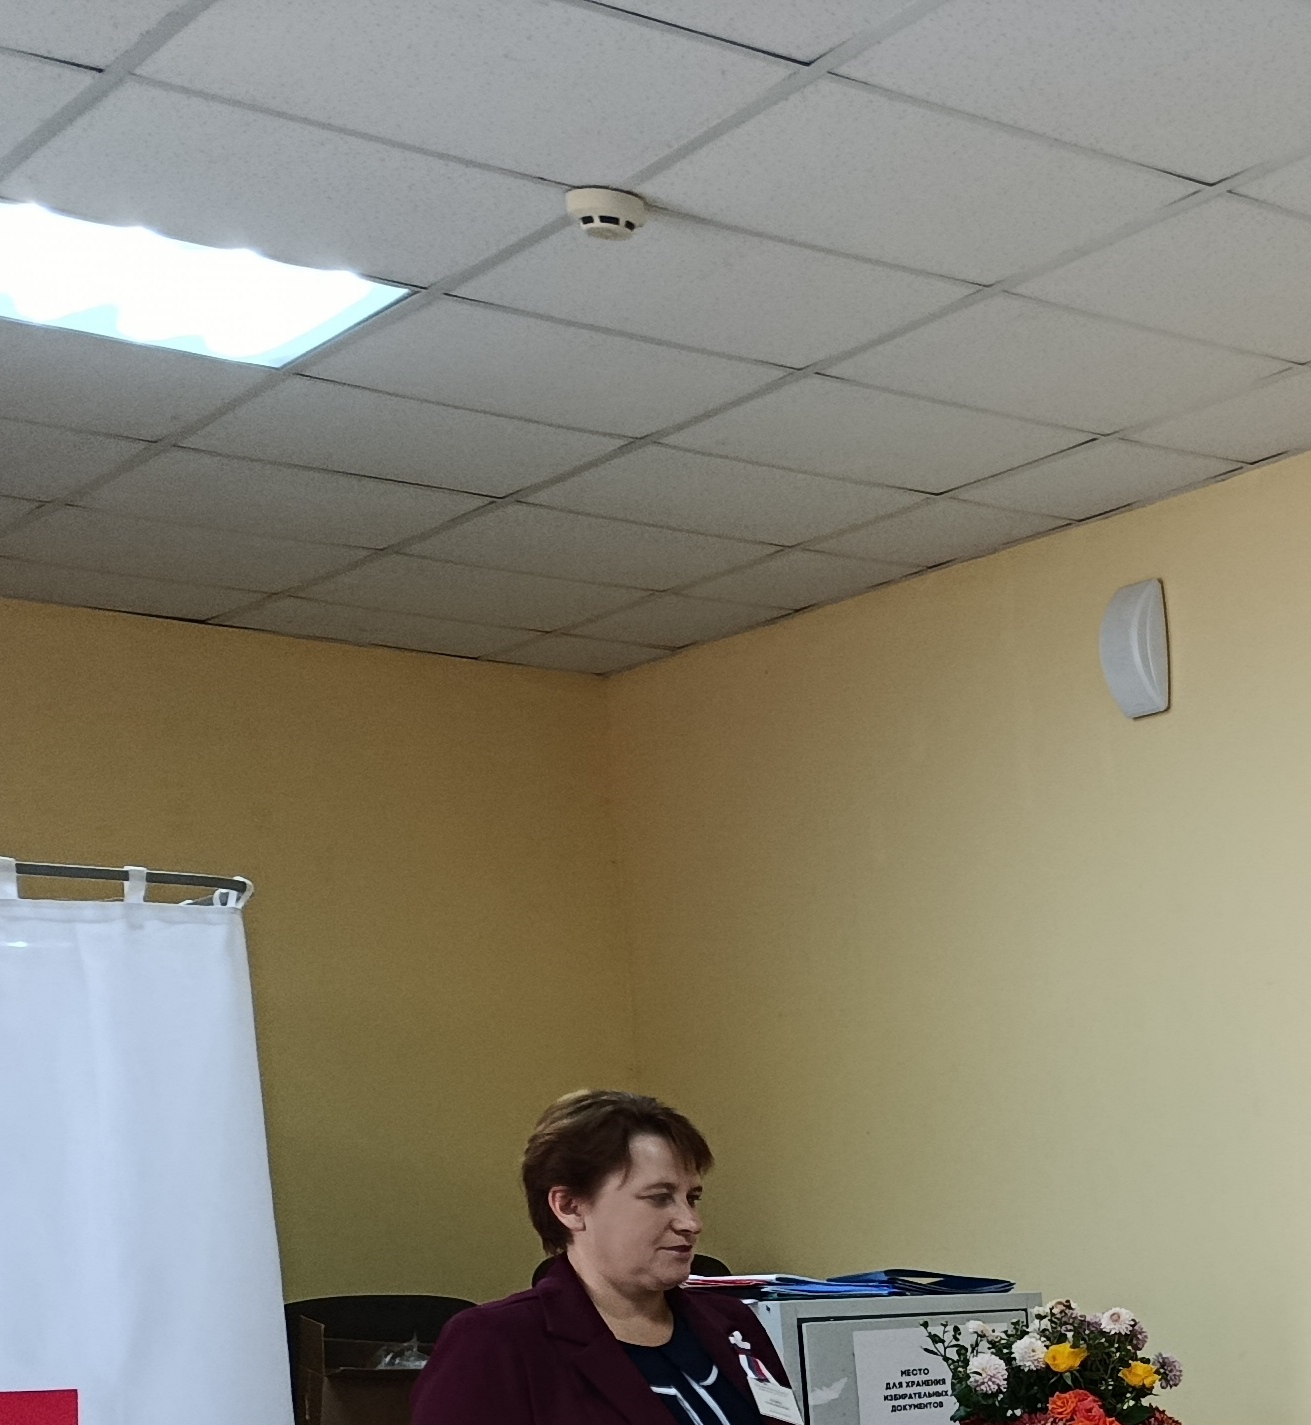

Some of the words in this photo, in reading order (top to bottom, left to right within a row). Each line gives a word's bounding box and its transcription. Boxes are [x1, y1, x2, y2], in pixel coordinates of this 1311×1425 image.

[900, 1368, 930, 1377] МЕСТО
[885, 1381, 904, 1390] ДЛЯ
[905, 1378, 946, 1388] ХРАНЕНИЯ
[883, 1390, 949, 1402] ИЗБИРАТЕЛЬНЫХ
[890, 1401, 944, 1413] ДОКУМЕНТОВ
